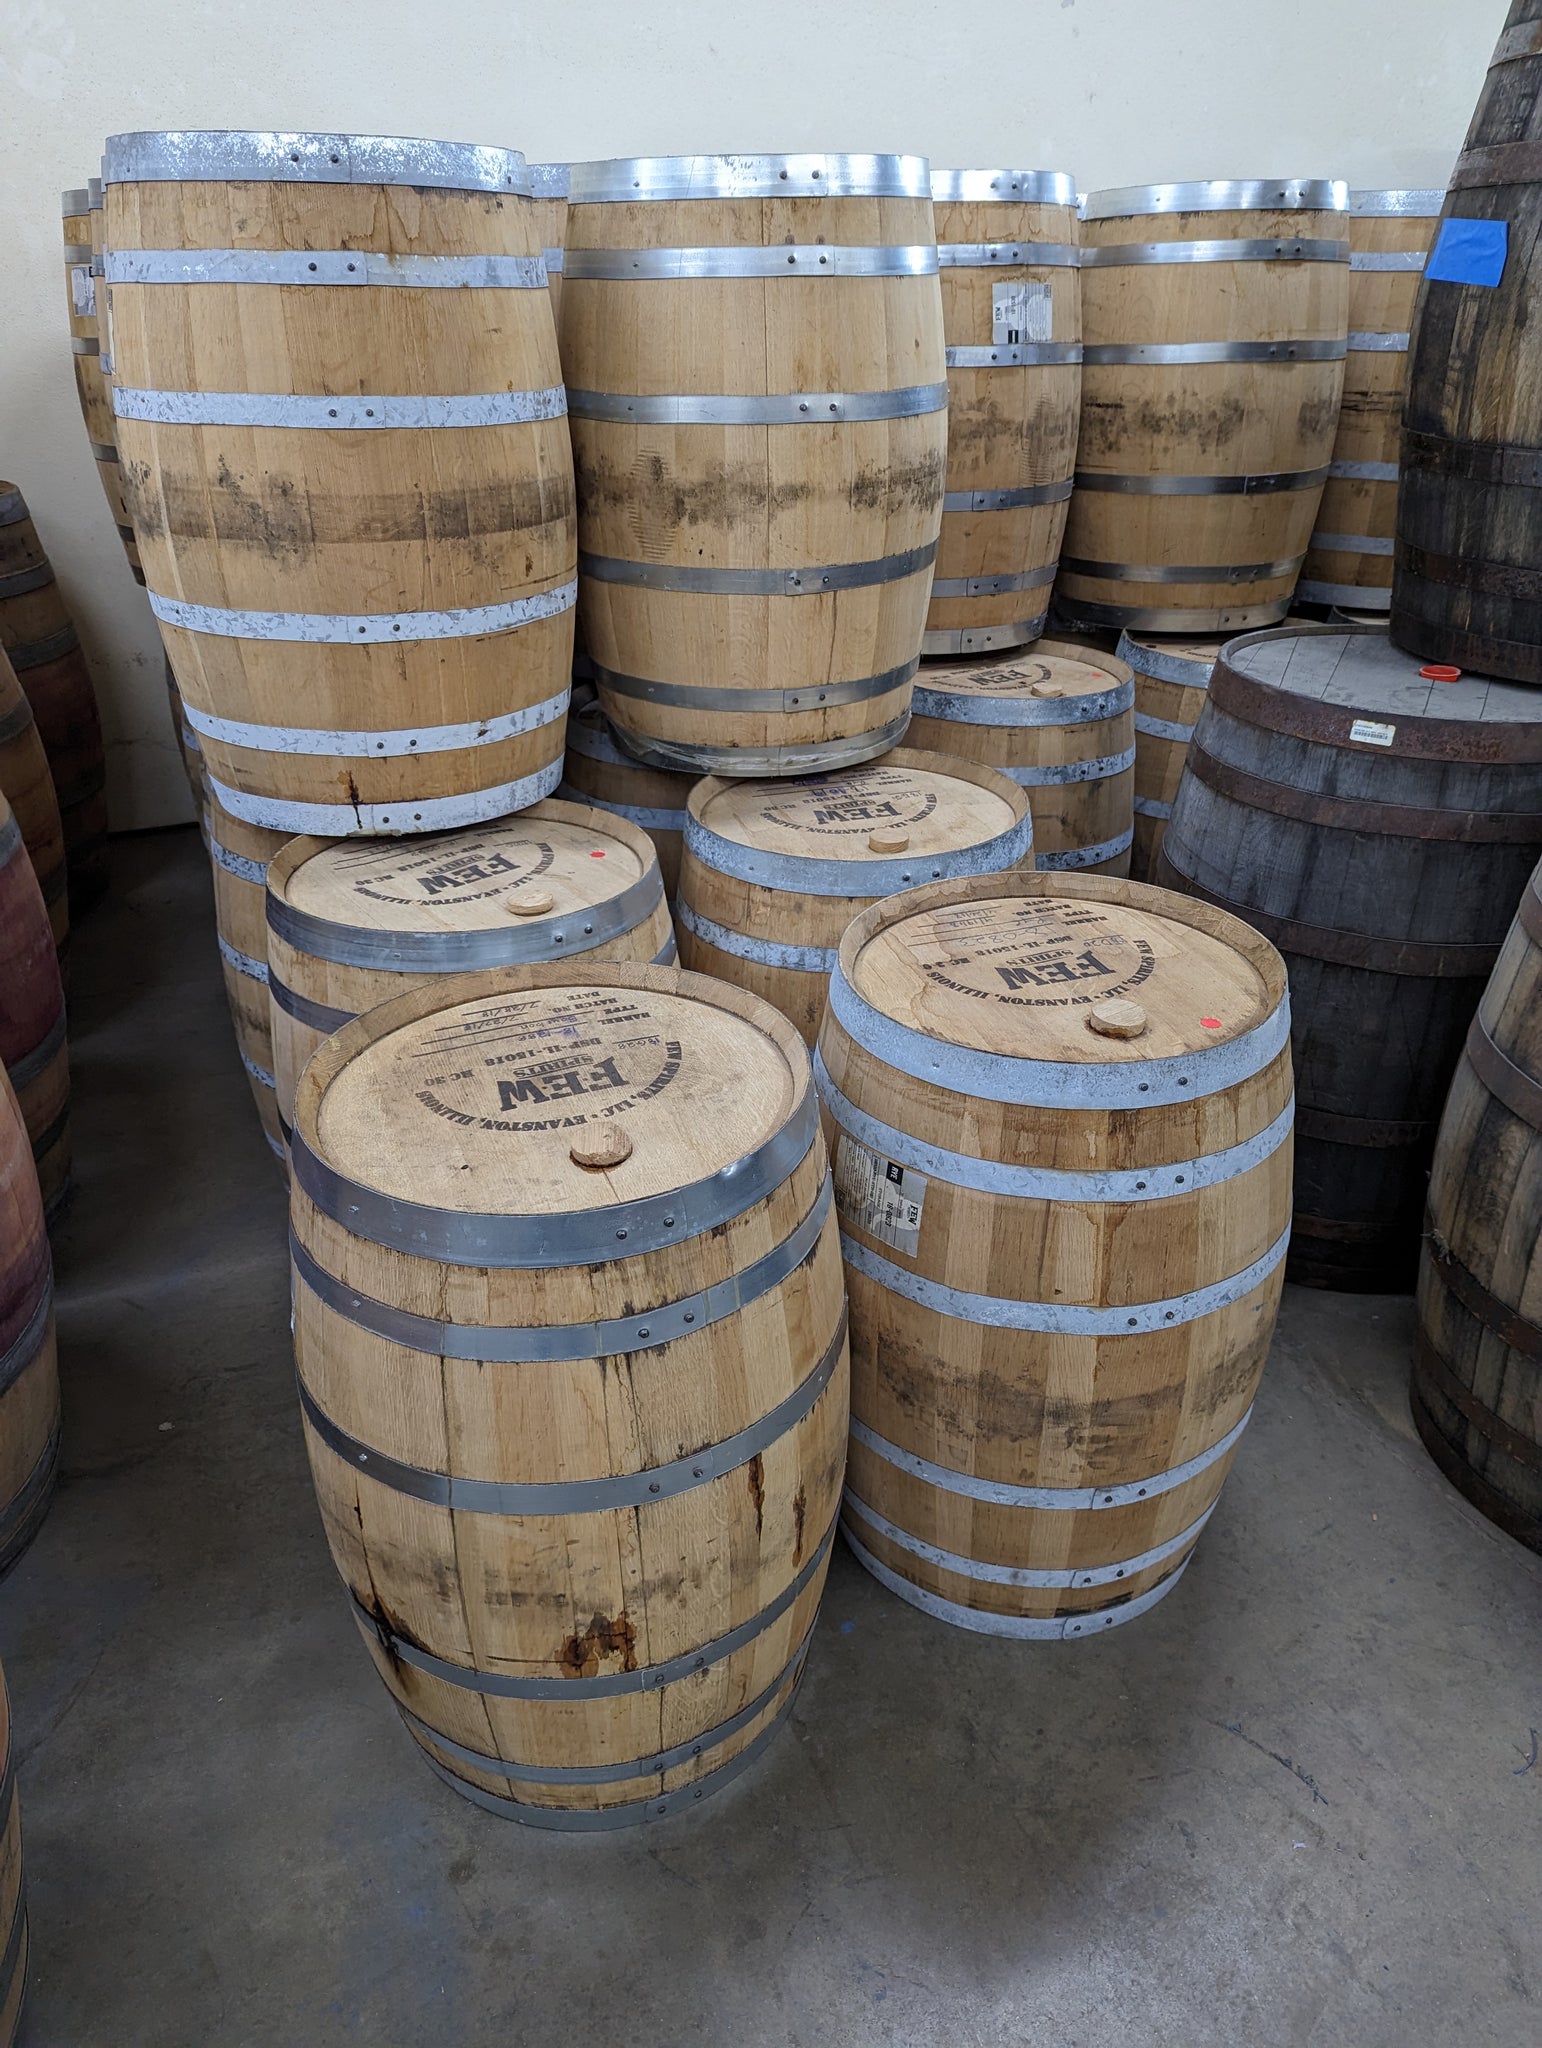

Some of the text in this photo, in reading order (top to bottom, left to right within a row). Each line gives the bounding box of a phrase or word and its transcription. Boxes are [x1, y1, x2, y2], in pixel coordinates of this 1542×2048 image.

[813, 801, 903, 825] FEW
[416, 853, 522, 895] FEW
[1012, 904, 1073, 917] BATCH NO.
[1024, 899, 1054, 907] DATE
[1061, 916, 1109, 926] BARREL
[975, 935, 1074, 956] DSP-IL-15018
[951, 957, 971, 966] RC
[1006, 949, 1074, 966] SPIRITS
[926, 939, 1155, 1007] FEW SPIRITS, LLC EVANSTON, ILLINOIS
[994, 950, 1117, 991] FEW
[548, 997, 619, 1014] BATCH NO.
[567, 991, 601, 1002] DATE
[603, 1004, 639, 1015] TYPE
[597, 1012, 652, 1026] BARREL
[484, 1037, 603, 1067] DSP-IL-15018
[512, 1055, 594, 1078] SPIRITS
[415, 1040, 682, 1132] FEW SPIRITS, LLC EVANSTON, ILLINOIS
[424, 1069, 475, 1087] RC 30
[497, 1056, 630, 1112] FEW
[890, 1166, 898, 1181] RYE
[908, 1204, 919, 1226] FEW
